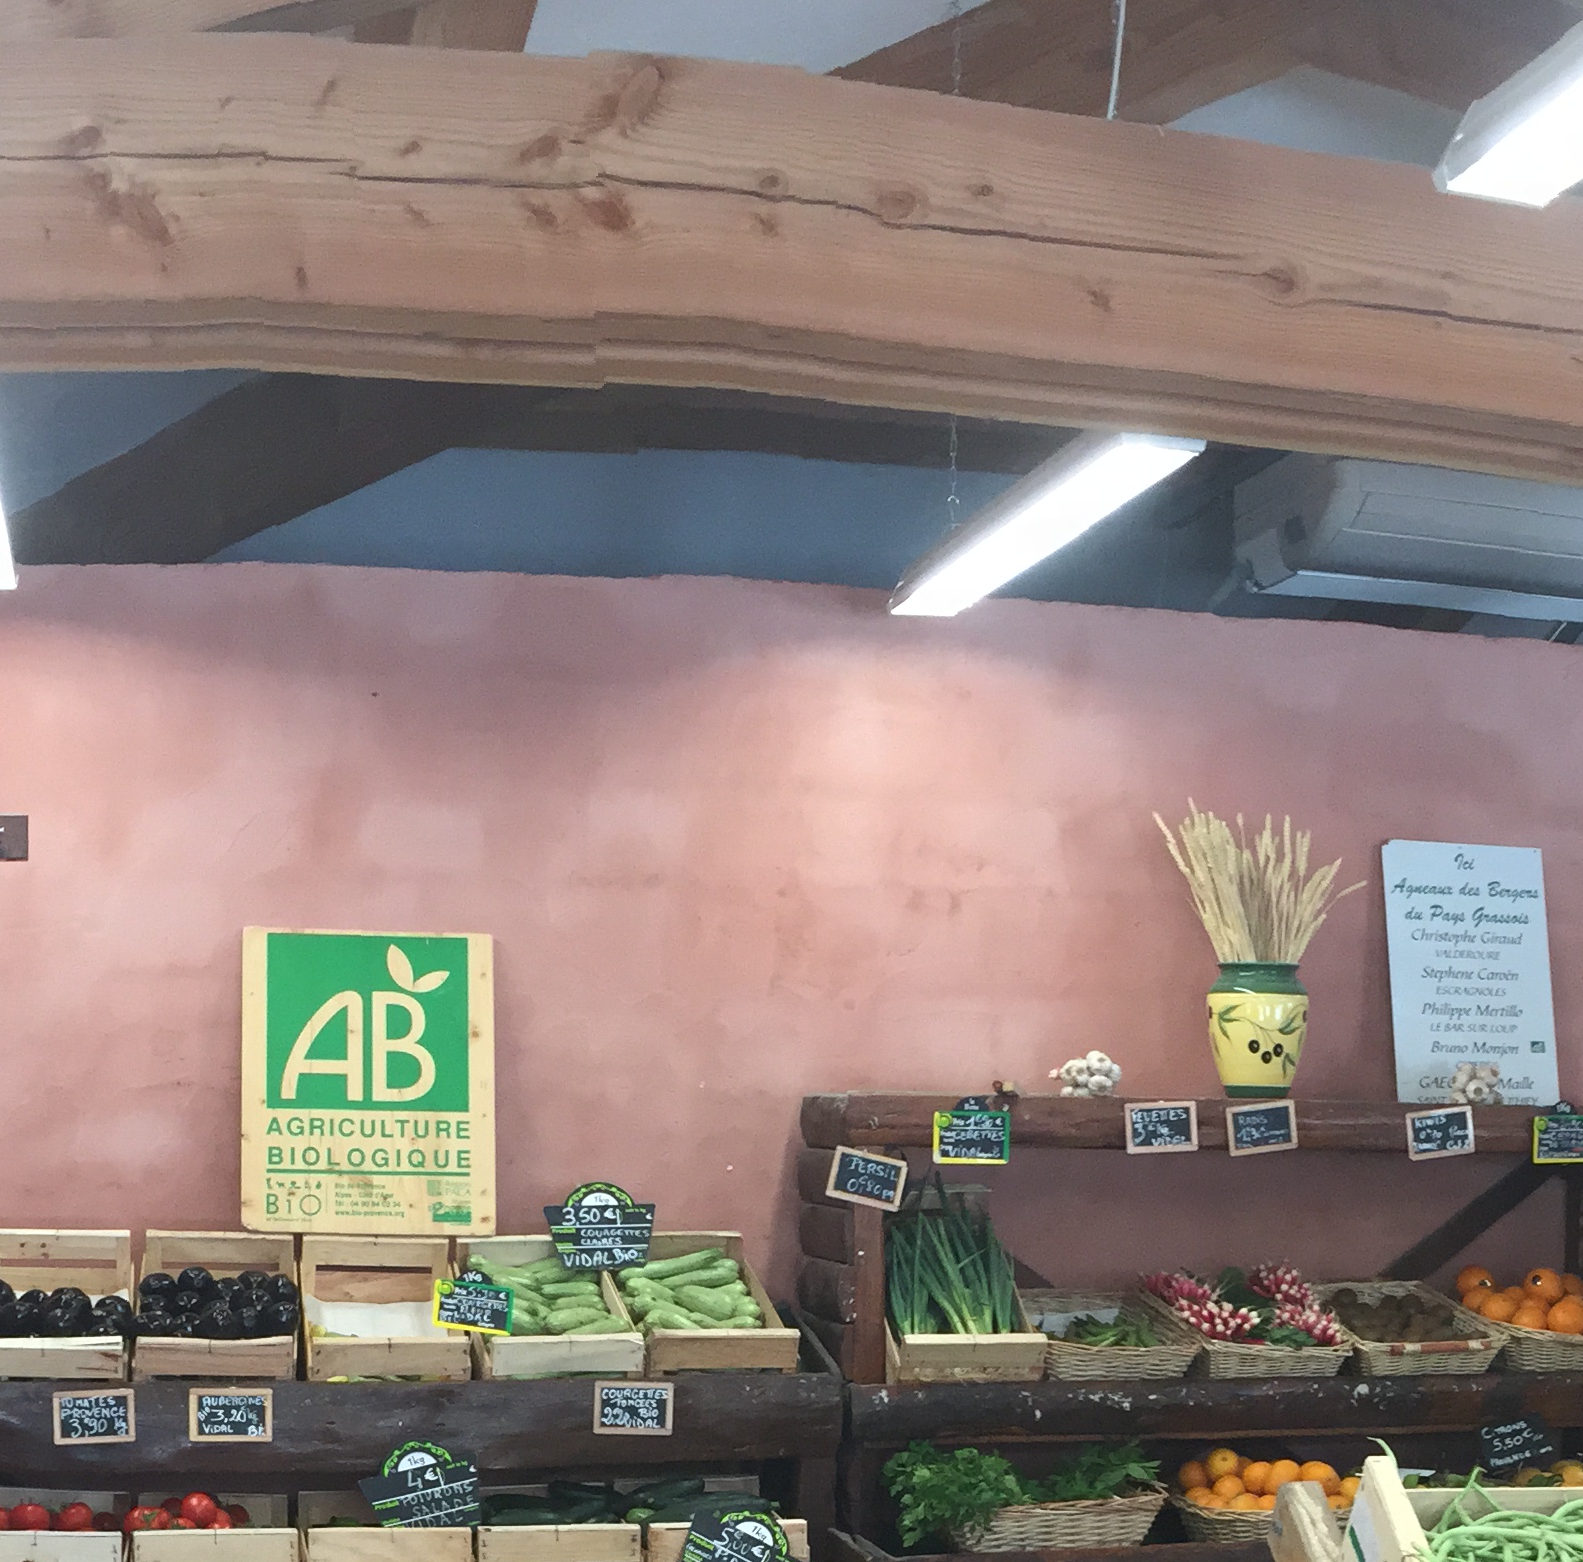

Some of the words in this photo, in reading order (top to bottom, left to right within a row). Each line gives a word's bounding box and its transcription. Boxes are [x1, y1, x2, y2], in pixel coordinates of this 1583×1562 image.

[1454, 853, 1475, 870] Ici
[1391, 877, 1453, 899] Agneaux
[1459, 882, 1480, 897] des
[1487, 881, 1539, 903] Bergers
[1404, 906, 1423, 921] du
[1429, 904, 1466, 925] Pays
[1471, 906, 1530, 928] Grassois
[1411, 928, 1476, 947] Christophe
[1480, 931, 1523, 945] Giraud
[1421, 966, 1473, 982] Stephene
[1435, 986, 1507, 997] ESCRAGNOLES
[1421, 1003, 1471, 1020] Philippe
[1430, 1023, 1441, 1032] LE
[1444, 1023, 1464, 1032] BAR
[1467, 1023, 1488, 1033] SUR
[1489, 1024, 1518, 1033] LOUP
[280, 989, 437, 1102] AB
[1431, 1040, 1468, 1053] Bruno
[265, 1117, 471, 1139] AGRICULTURE
[267, 1146, 472, 1169] BIOLOGIQUE
[580, 1229, 650, 1238] COURGETTES
[61, 1406, 127, 1420] PROVENCE
[412, 1495, 474, 1517] SALADE
